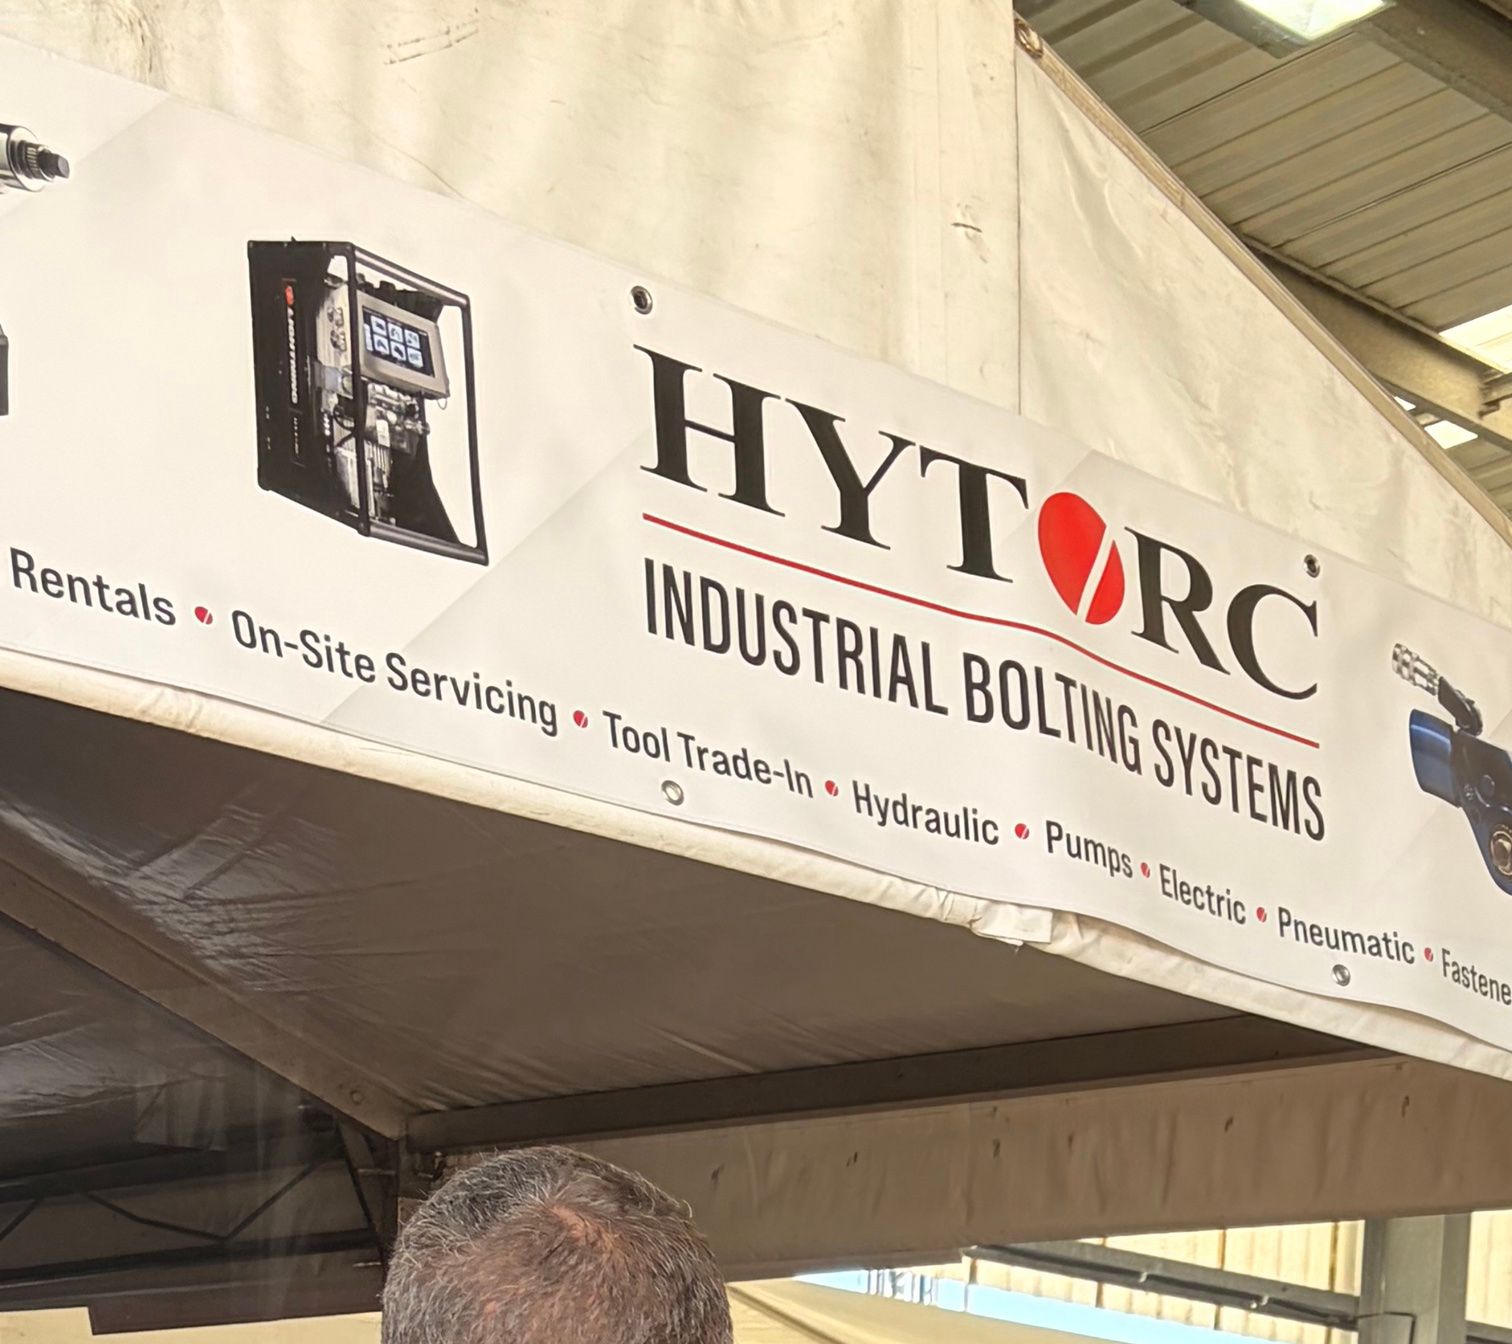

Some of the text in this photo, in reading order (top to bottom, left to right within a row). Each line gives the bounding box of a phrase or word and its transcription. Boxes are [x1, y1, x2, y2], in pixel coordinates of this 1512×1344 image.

[633, 345, 1319, 700] HYTORC
[643, 557, 1326, 842] INDUSTRIAL BOLTING SYSTEMS
[8, 546, 177, 626] Rentals
[230, 609, 376, 684] On-Site
[387, 651, 558, 738] Servicing
[602, 710, 671, 763] Tool
[676, 731, 814, 799] Trade-In
[851, 779, 1000, 846] Hydraulic
[1045, 819, 1134, 880] Pumps
[1159, 863, 1246, 925] Electric
[1277, 906, 1416, 965] Pneumatic
